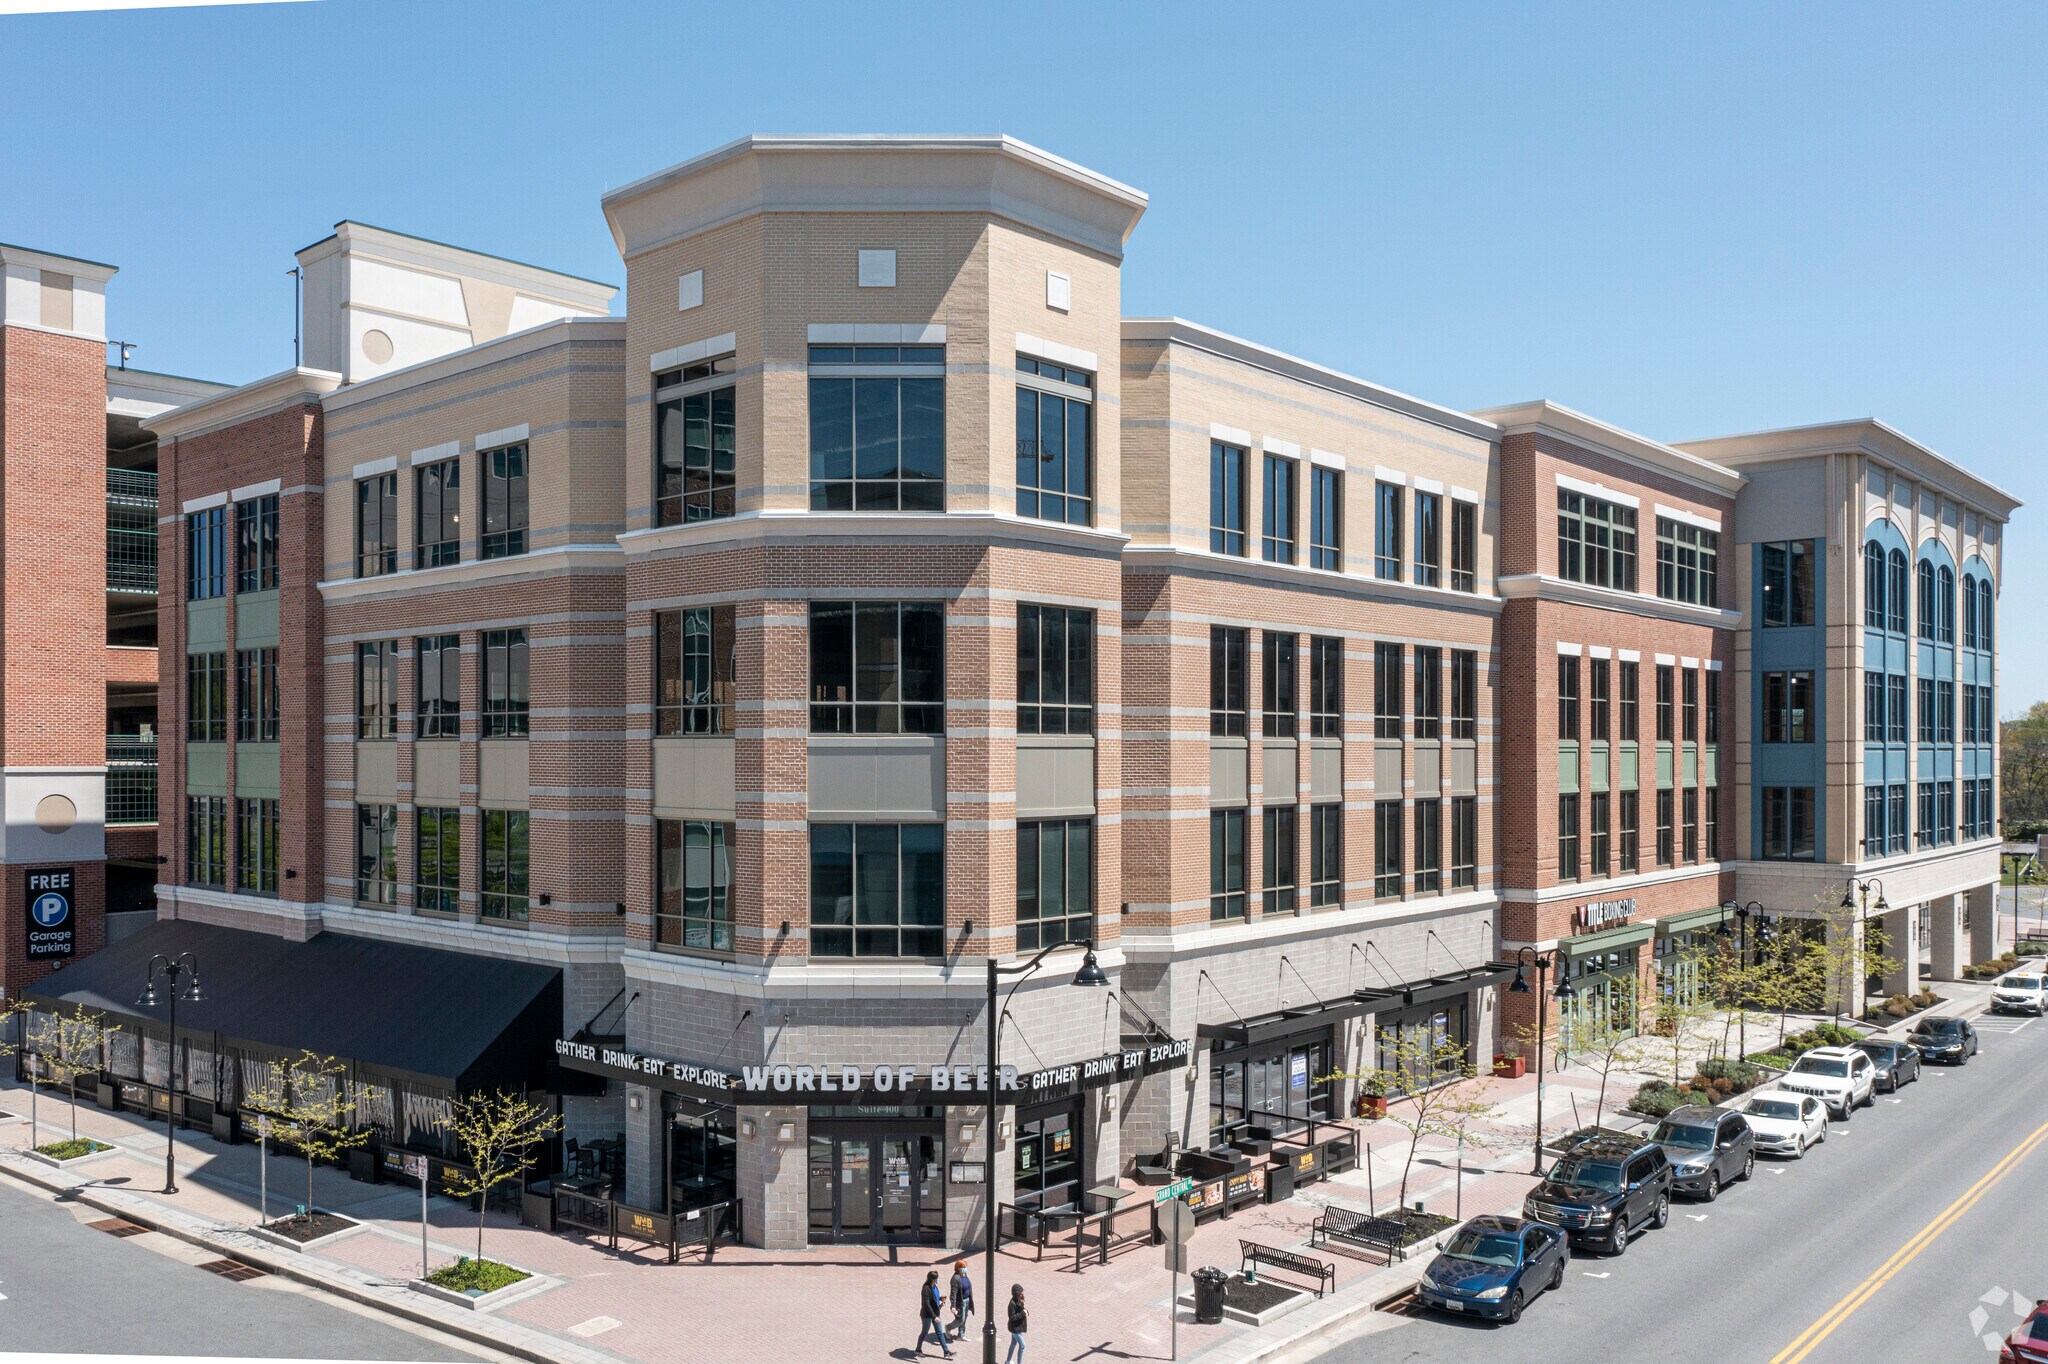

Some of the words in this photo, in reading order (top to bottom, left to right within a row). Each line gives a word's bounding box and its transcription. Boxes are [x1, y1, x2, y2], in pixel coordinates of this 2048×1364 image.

[30, 873, 70, 890] FREE
[42, 898, 62, 922] P
[1587, 902, 1604, 927] TITLE
[1604, 900, 1624, 921] BOXING
[1624, 898, 1636, 917] CLUB
[29, 931, 72, 942] Garage
[30, 942, 71, 953] Parking
[555, 1039, 596, 1061] GATHER
[602, 1049, 636, 1070] DRINK
[643, 1057, 665, 1076] EAT
[673, 1064, 728, 1090] EXPLORE
[1032, 1065, 1077, 1090] GATHER
[1084, 1056, 1117, 1078] DRINK
[1123, 1051, 1143, 1069] EAT
[1150, 1039, 1192, 1063] EXPLORE
[742, 1065, 862, 1092] WORLD
[873, 1065, 917, 1092] OF
[931, 1065, 1019, 1092] BEER
[857, 1105, 881, 1114] Suite
[1156, 1187, 1171, 1202] GRAND
[1171, 1180, 1189, 1196] CENTRAL
